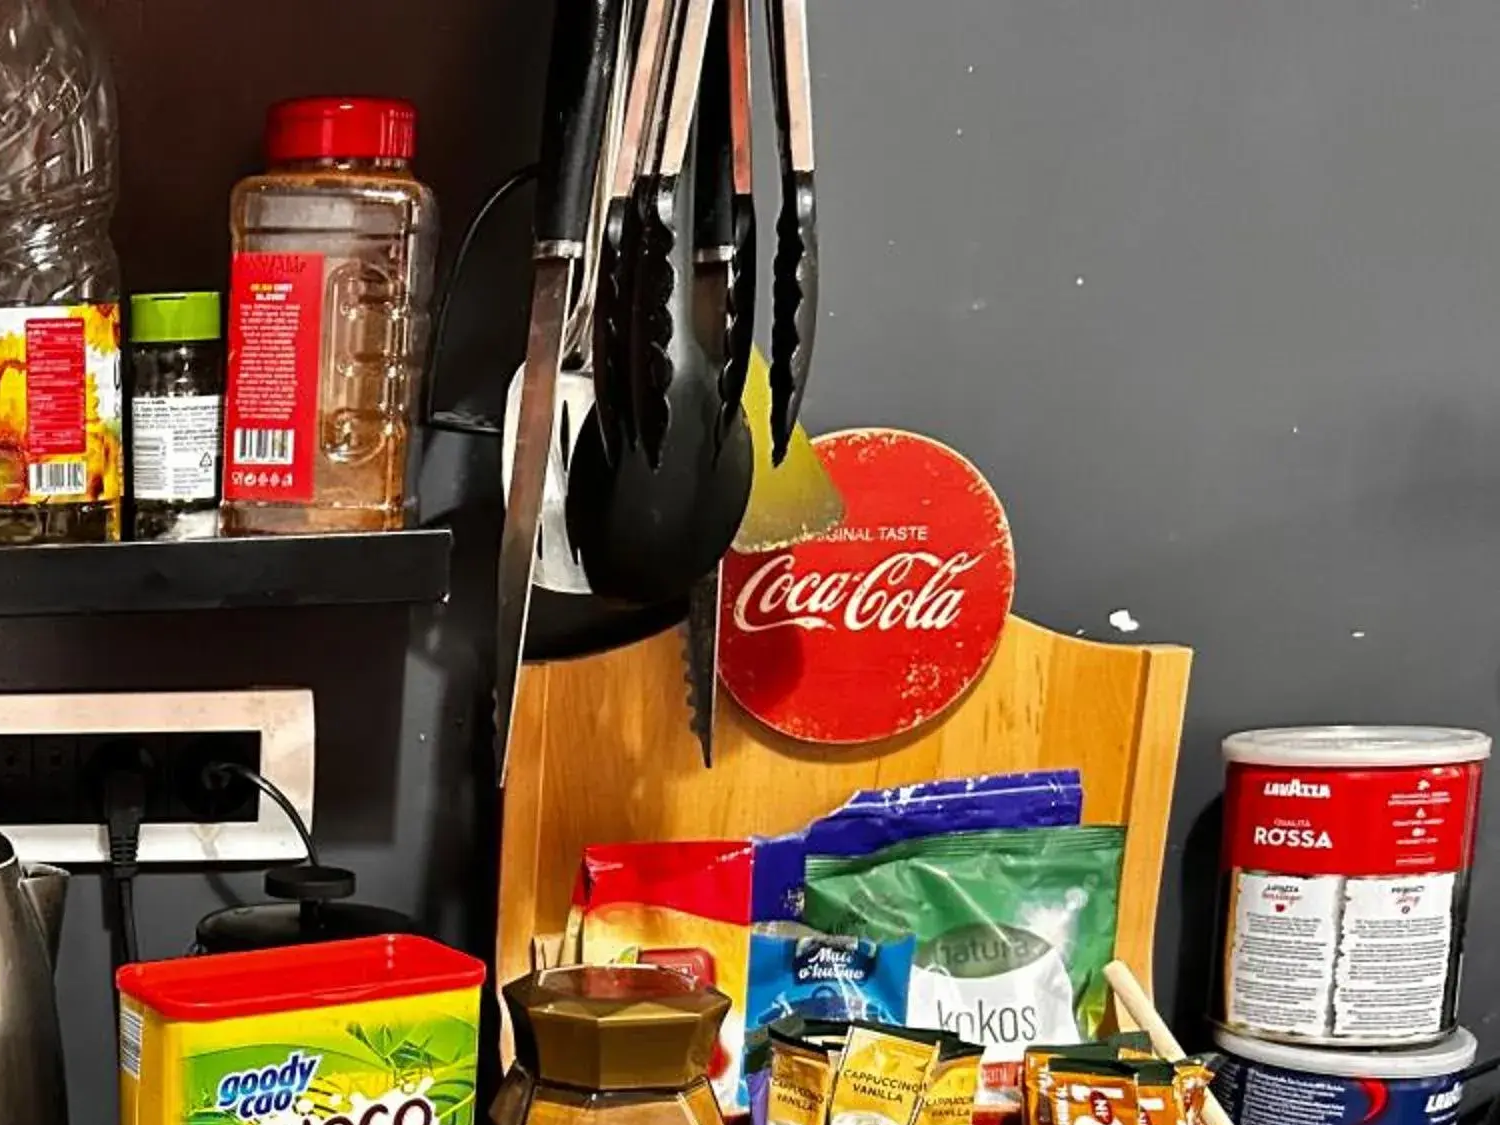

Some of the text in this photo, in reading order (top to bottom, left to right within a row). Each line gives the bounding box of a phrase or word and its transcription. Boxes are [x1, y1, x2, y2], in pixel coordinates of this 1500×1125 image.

[878, 525, 929, 541] TASTE
[733, 551, 986, 632] Coca-Cola
[1263, 779, 1332, 799] LAVAZZA
[1253, 826, 1334, 849] ROSSA
[937, 999, 1038, 1044] kokos
[219, 1054, 317, 1108] goody
[843, 1068, 921, 1094] CAPPUCCINO
[853, 1083, 904, 1104] VANILLA
[239, 1087, 293, 1119] cao
